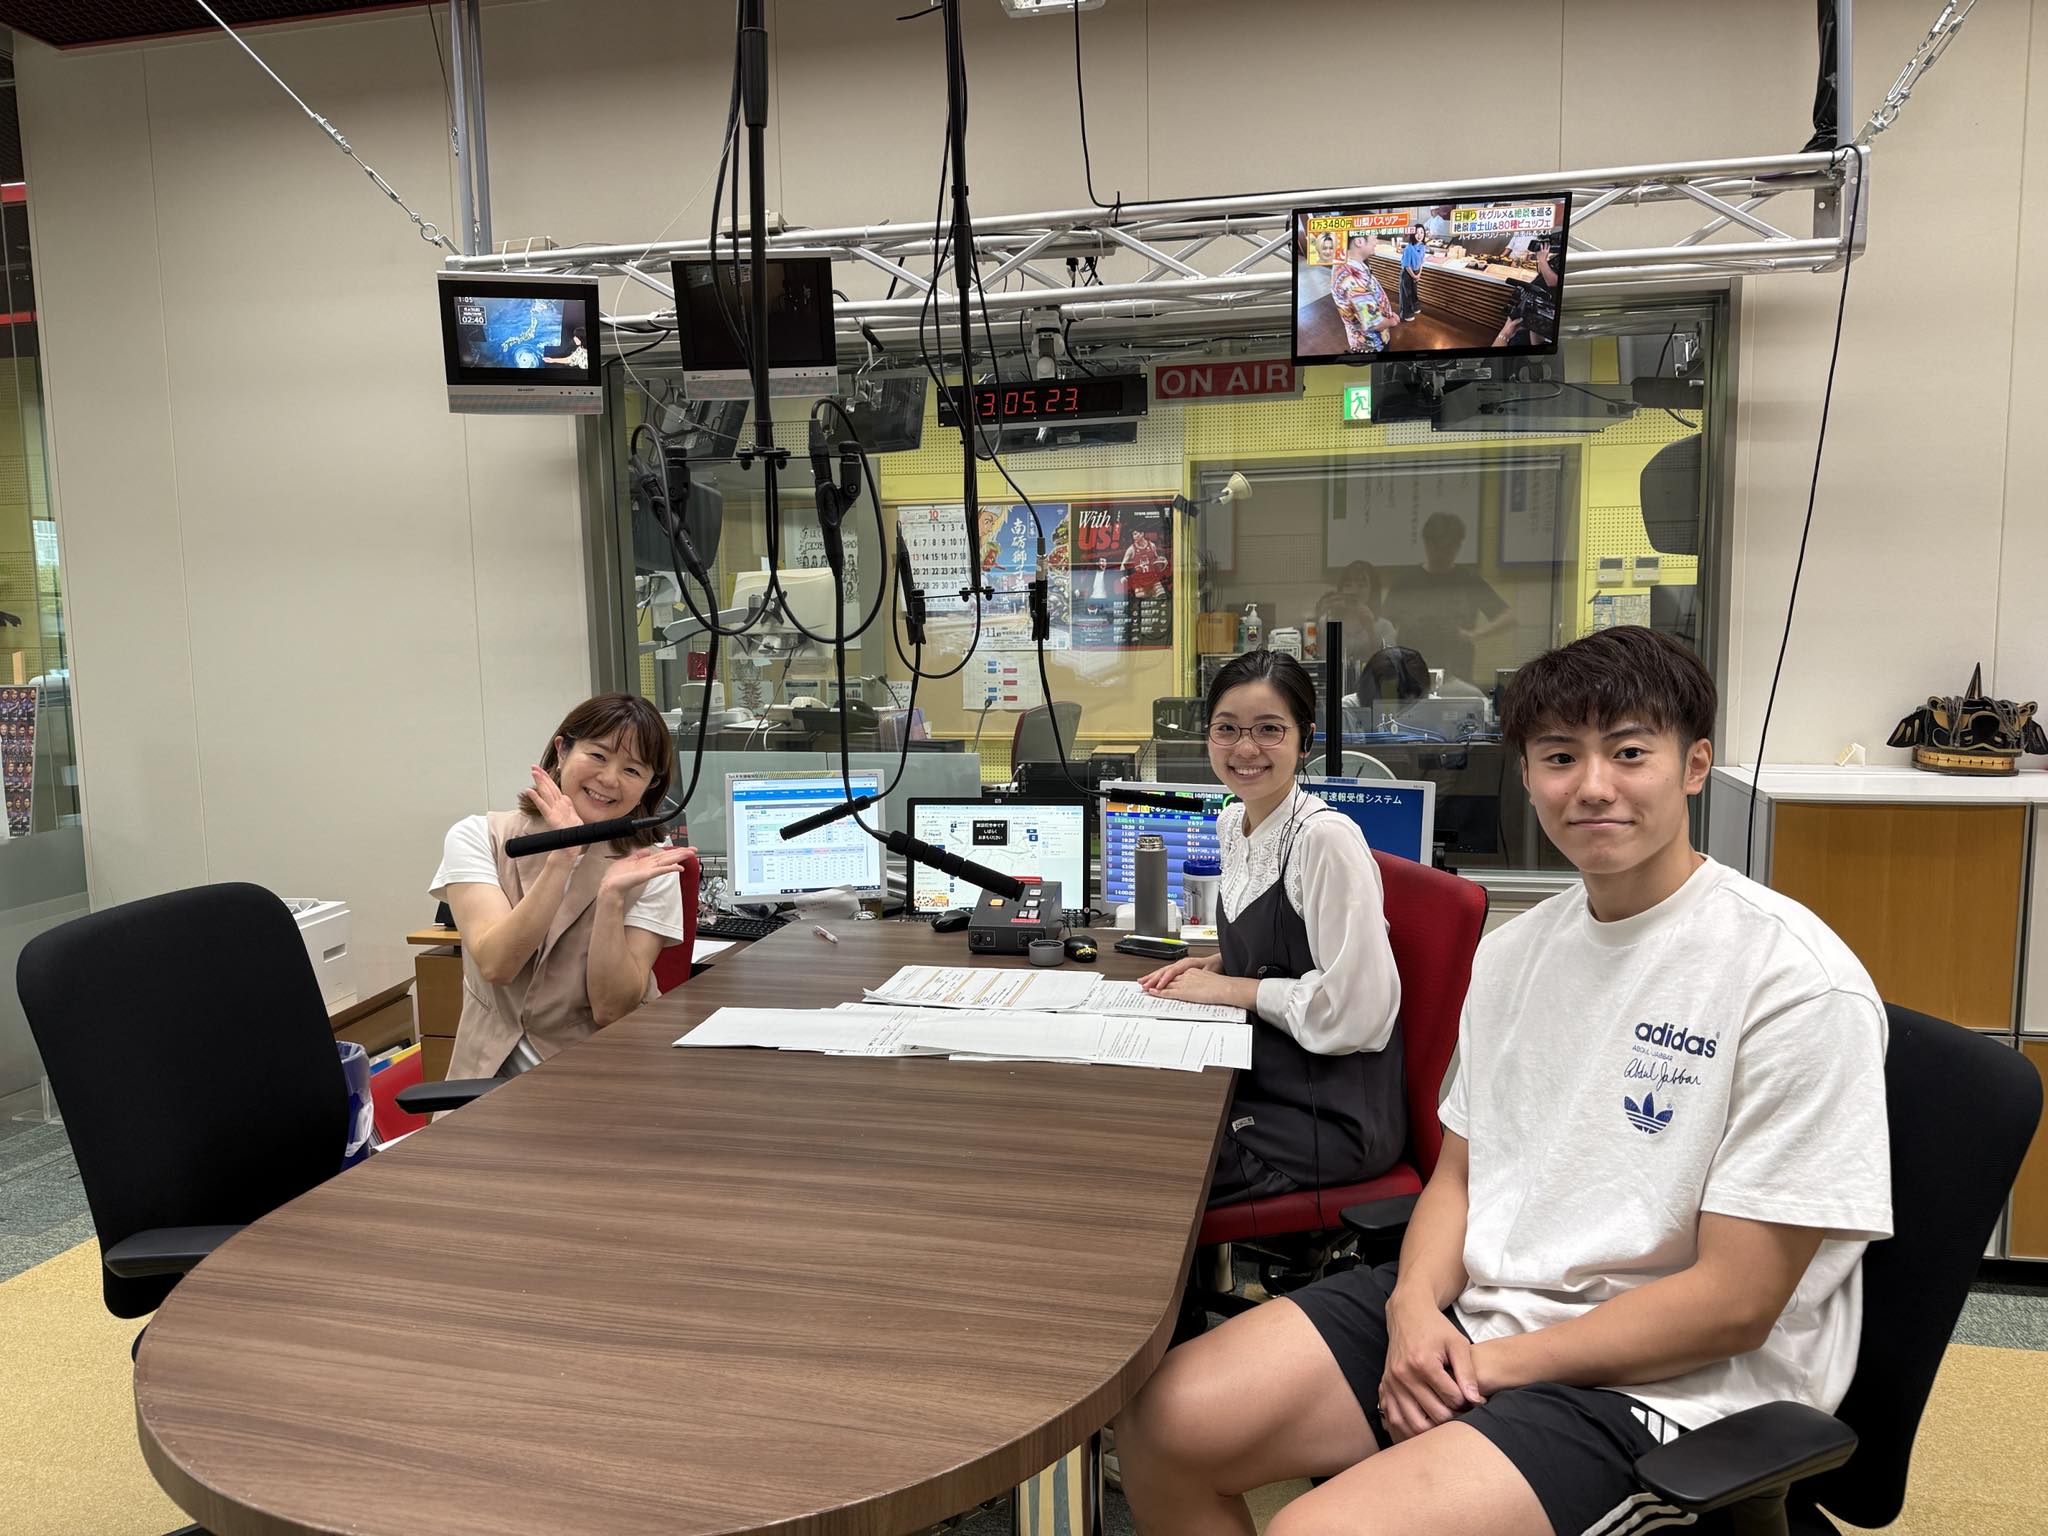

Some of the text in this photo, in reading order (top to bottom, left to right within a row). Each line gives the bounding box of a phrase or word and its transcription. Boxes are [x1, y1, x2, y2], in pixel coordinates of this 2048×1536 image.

[1161, 365, 1290, 394] ON AIR
[1078, 510, 1112, 529] With
[1077, 523, 1121, 551] US!
[1634, 1022, 1717, 1059] adidas
